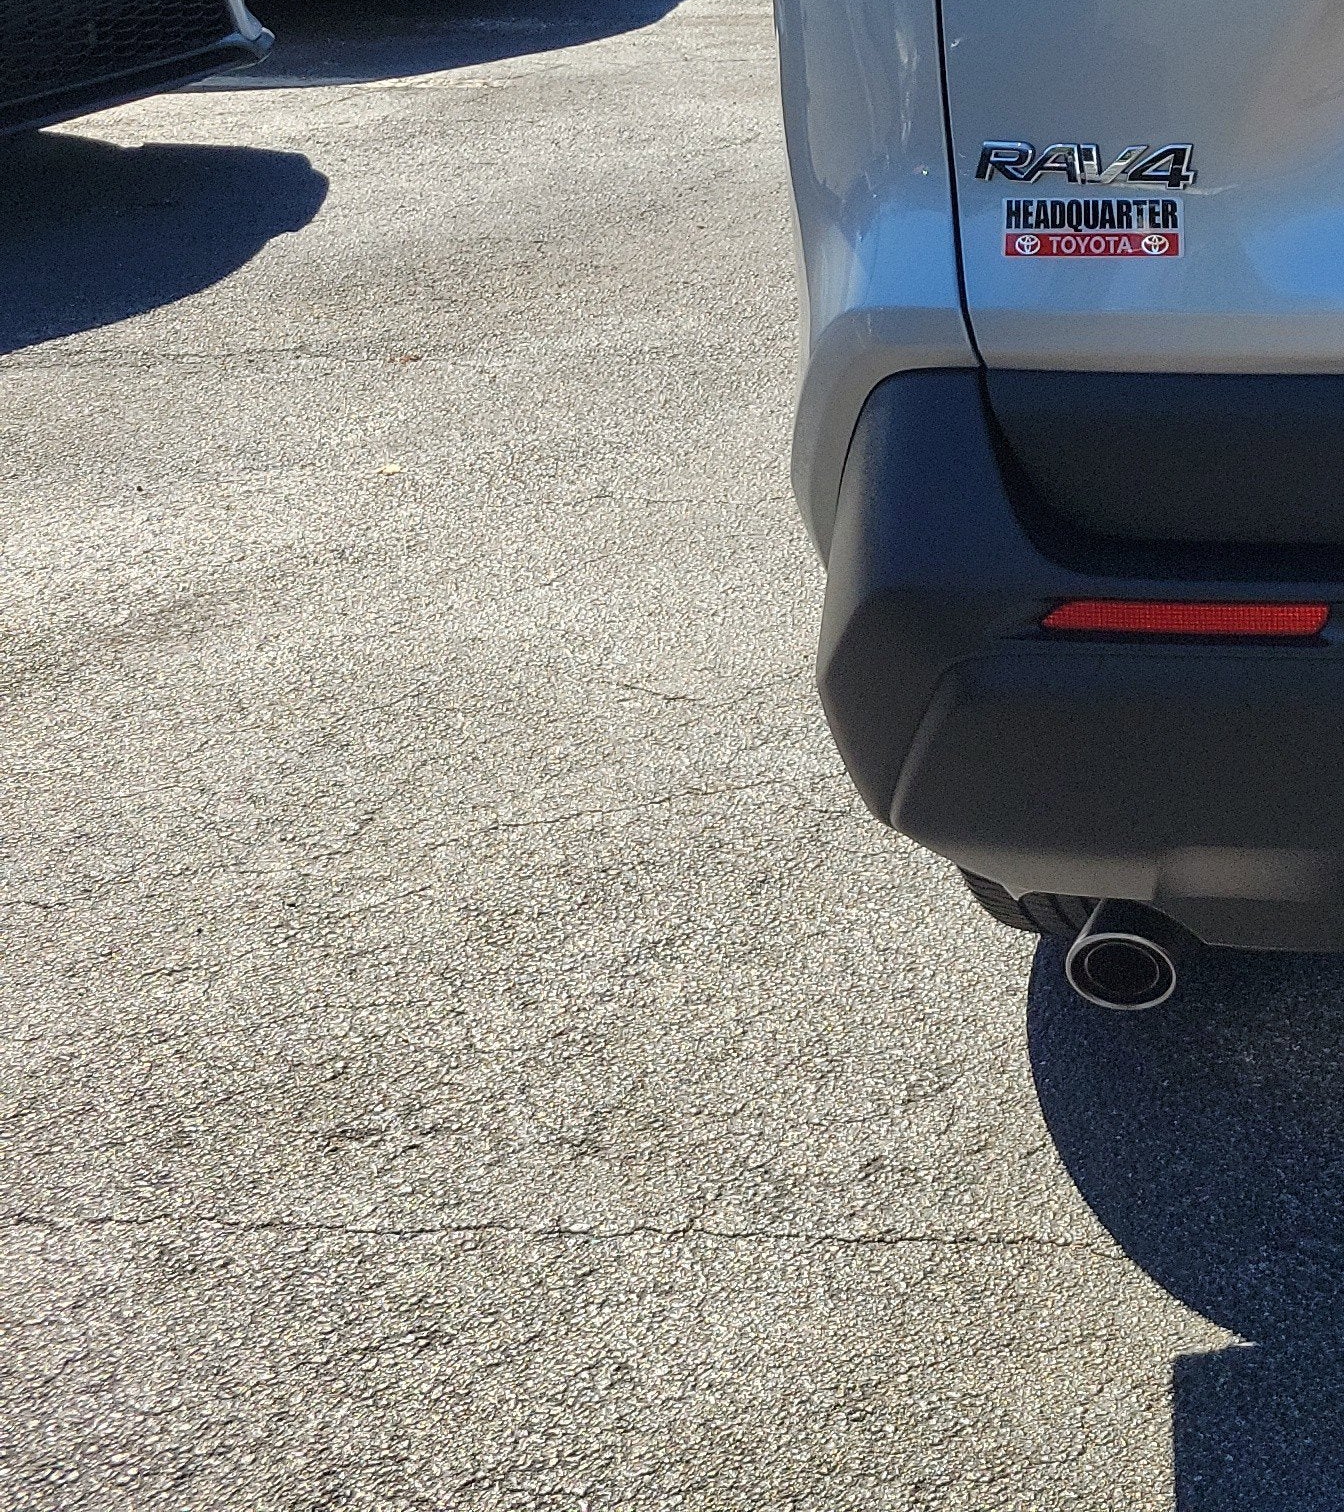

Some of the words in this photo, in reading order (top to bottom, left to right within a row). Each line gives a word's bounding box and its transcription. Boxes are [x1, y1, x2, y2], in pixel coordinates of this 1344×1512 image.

[975, 140, 1198, 190] RAV4
[1005, 199, 1179, 232] HEADQUARTER
[1049, 235, 1133, 254] TOYOTA
